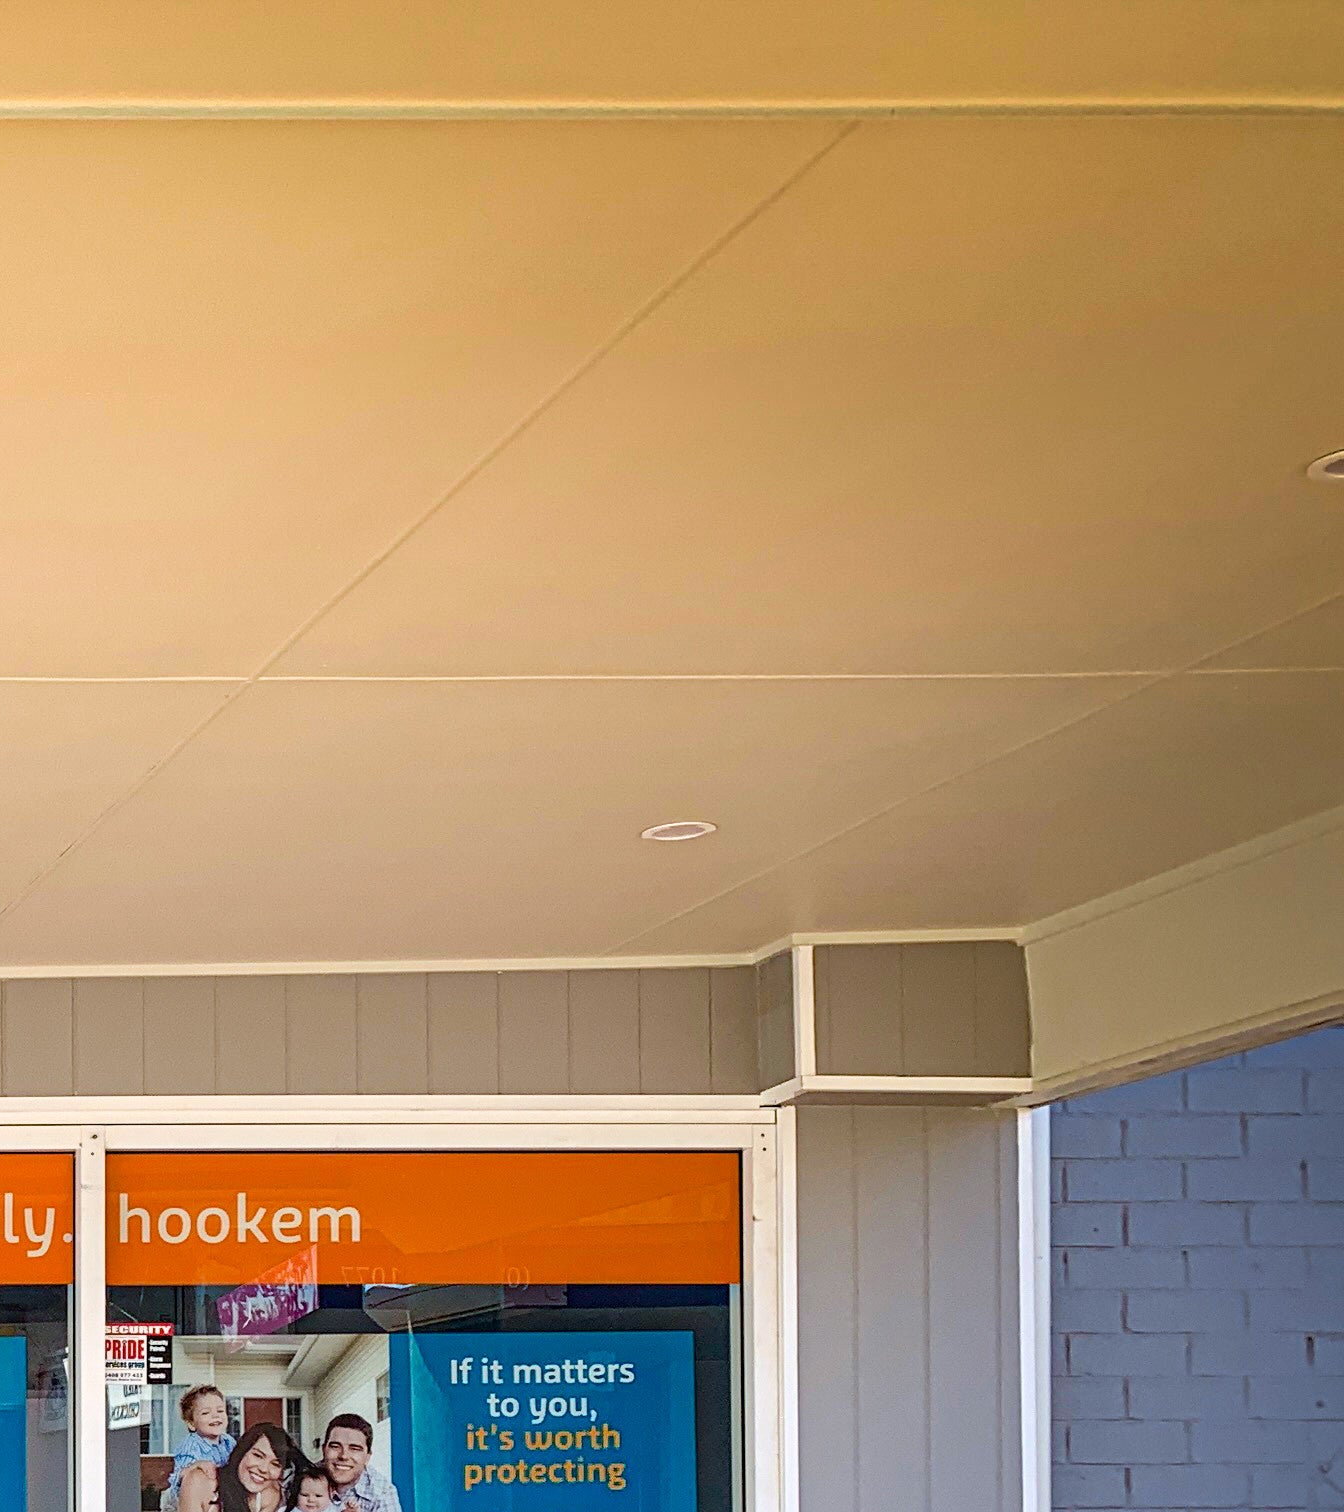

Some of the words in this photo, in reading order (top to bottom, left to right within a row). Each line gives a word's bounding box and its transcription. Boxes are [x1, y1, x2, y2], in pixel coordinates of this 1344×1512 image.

[120, 1193, 360, 1243] hookem
[451, 1358, 473, 1384] If
[482, 1358, 503, 1384] it
[514, 1360, 634, 1383] matters
[487, 1394, 519, 1417] to
[530, 1398, 596, 1424] you,
[467, 1424, 514, 1450] it's
[525, 1424, 620, 1450] worth
[465, 1458, 626, 1490] protecting
